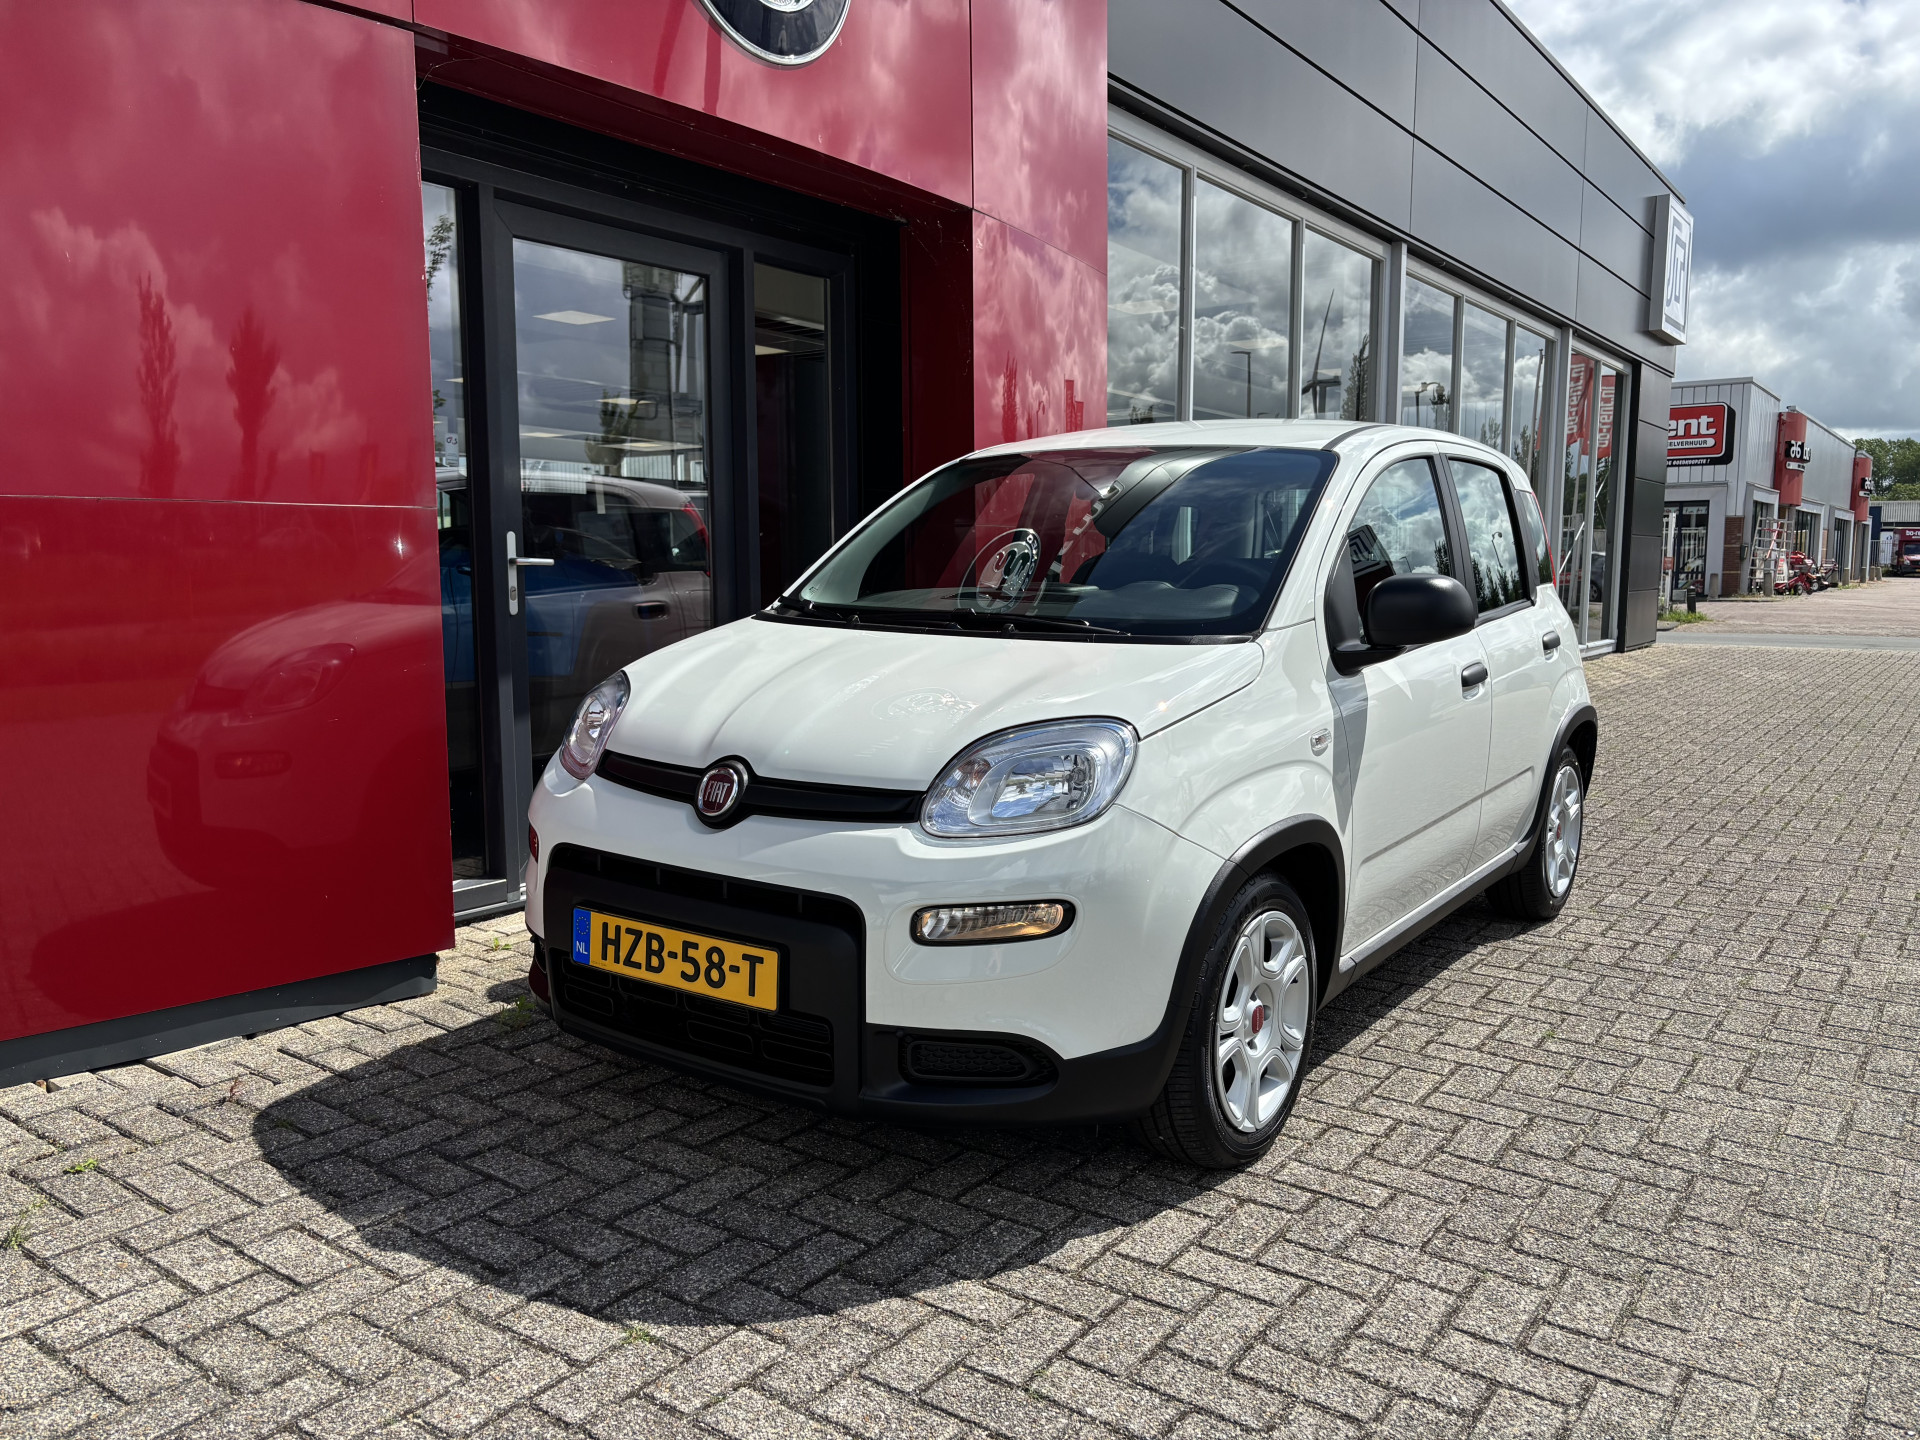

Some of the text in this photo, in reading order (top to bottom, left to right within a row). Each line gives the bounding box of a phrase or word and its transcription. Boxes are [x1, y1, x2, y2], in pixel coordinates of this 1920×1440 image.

[704, 780, 731, 804] FIAT
[575, 940, 588, 955] NL
[601, 921, 765, 997] HZB-58-T
